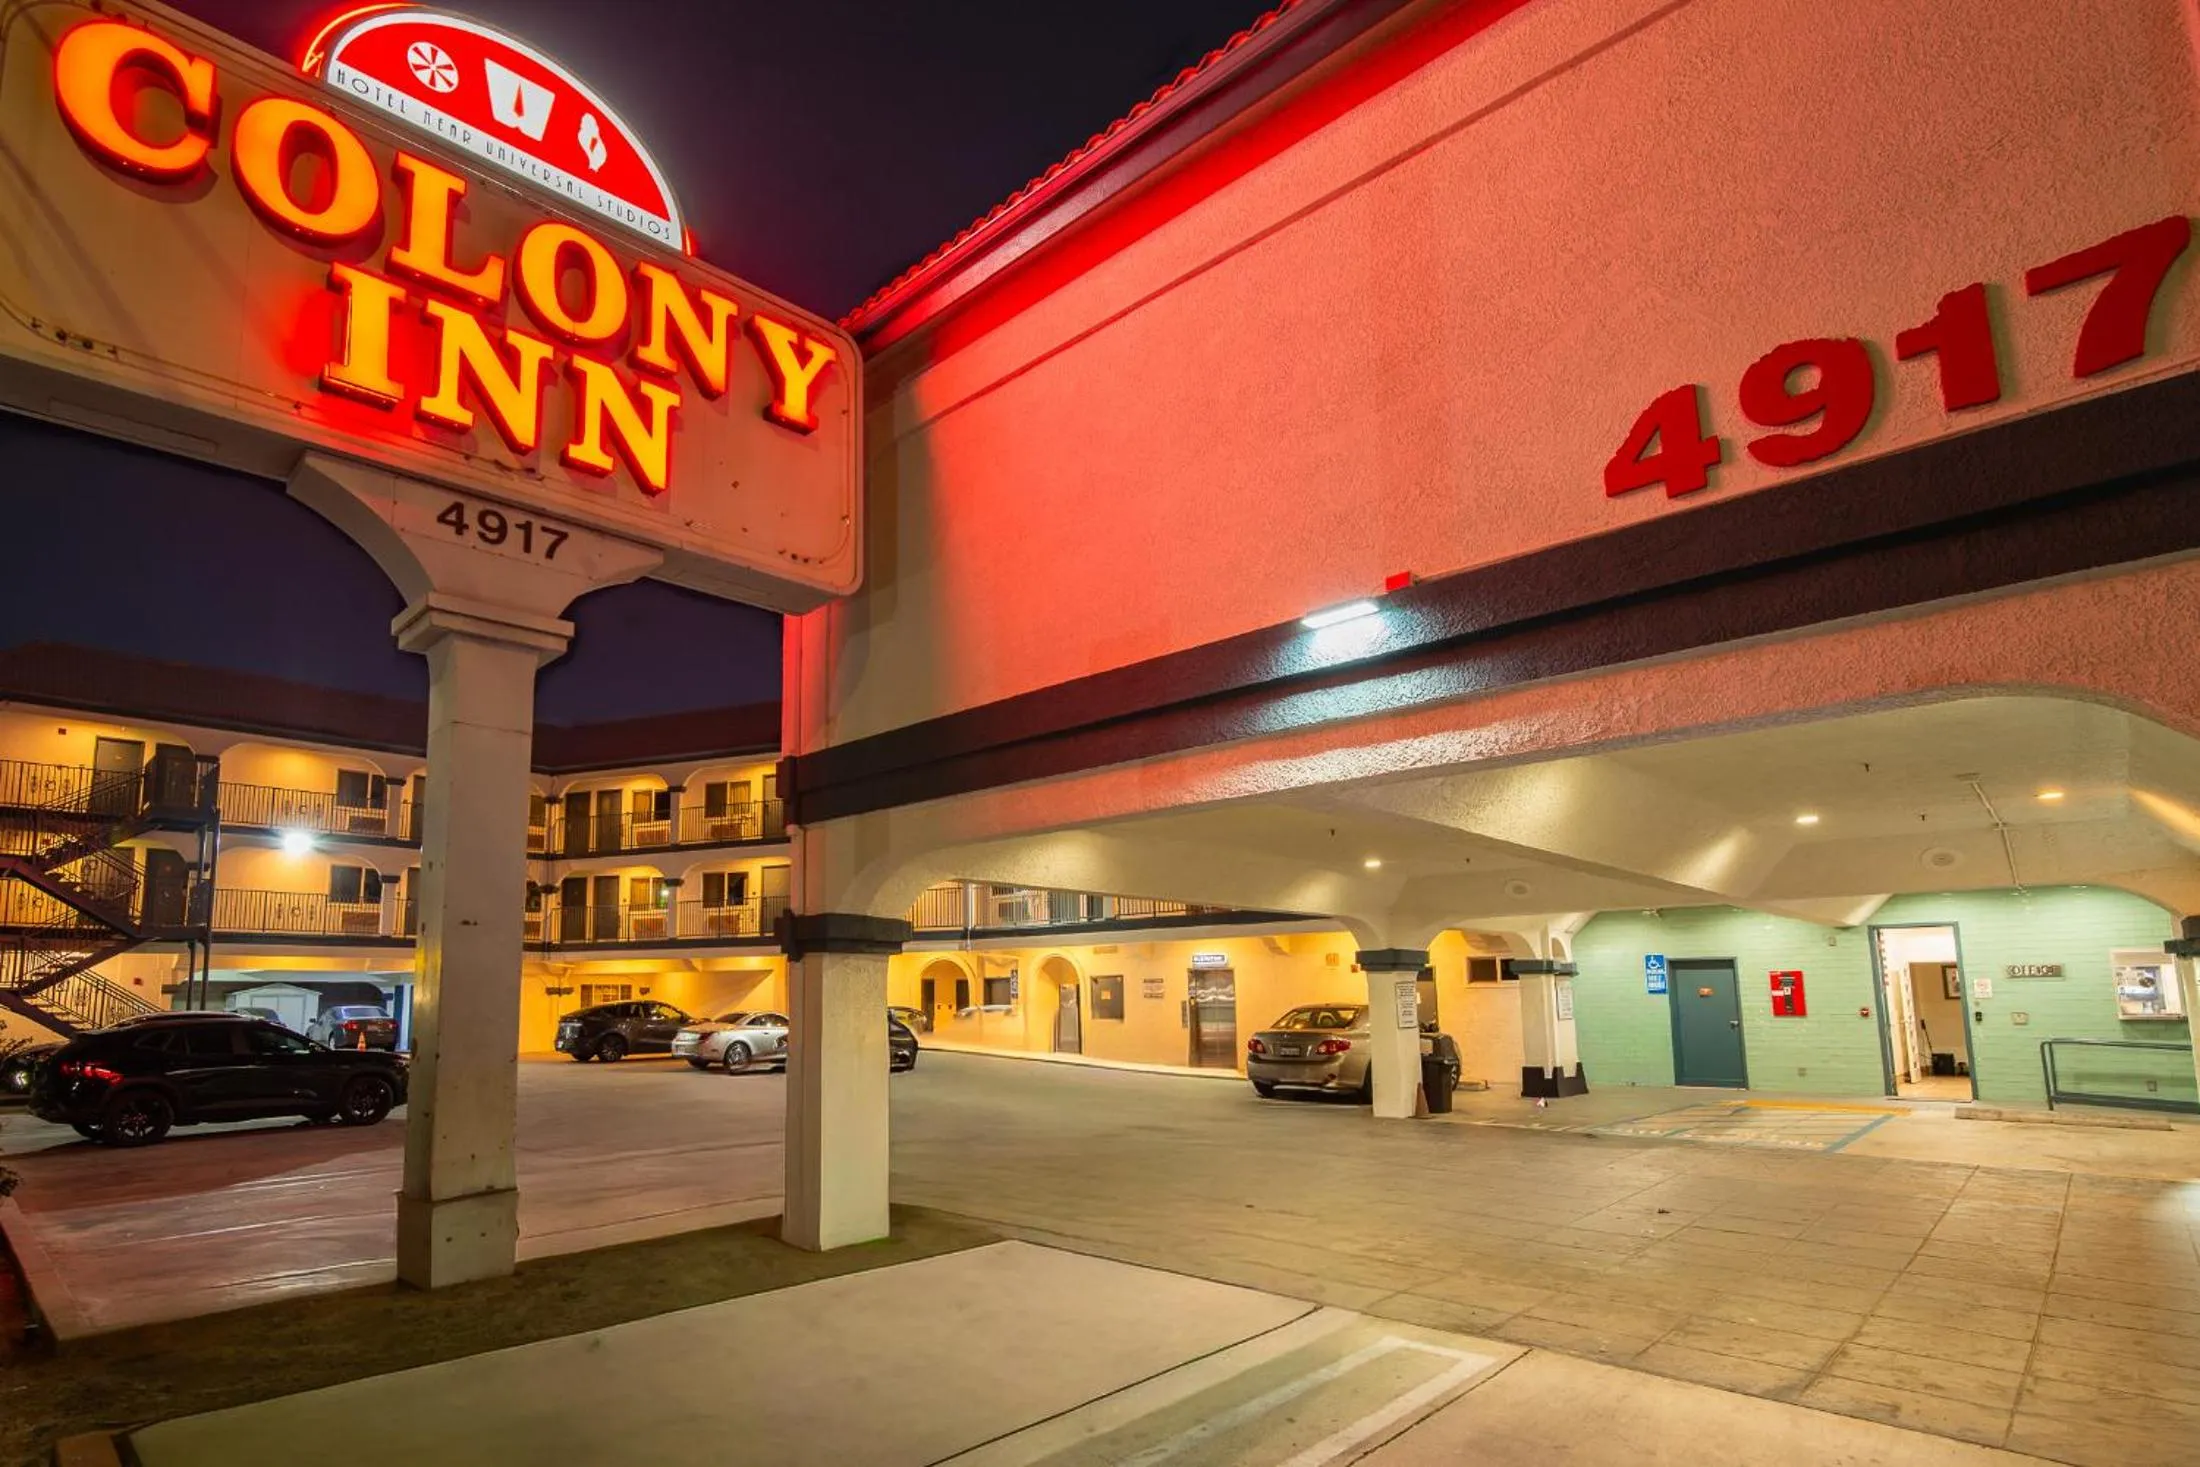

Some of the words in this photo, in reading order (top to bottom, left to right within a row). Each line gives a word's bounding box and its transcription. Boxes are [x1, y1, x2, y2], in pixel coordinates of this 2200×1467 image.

[54, 20, 836, 434] COLONY
[337, 68, 407, 115] HOTEL
[423, 109, 472, 146] NEAR
[485, 140, 584, 200] UNIVERSAL
[596, 194, 672, 241] STUDIOS
[318, 261, 681, 497] INN
[1604, 215, 2190, 499] 4917
[436, 501, 569, 560] 4917
